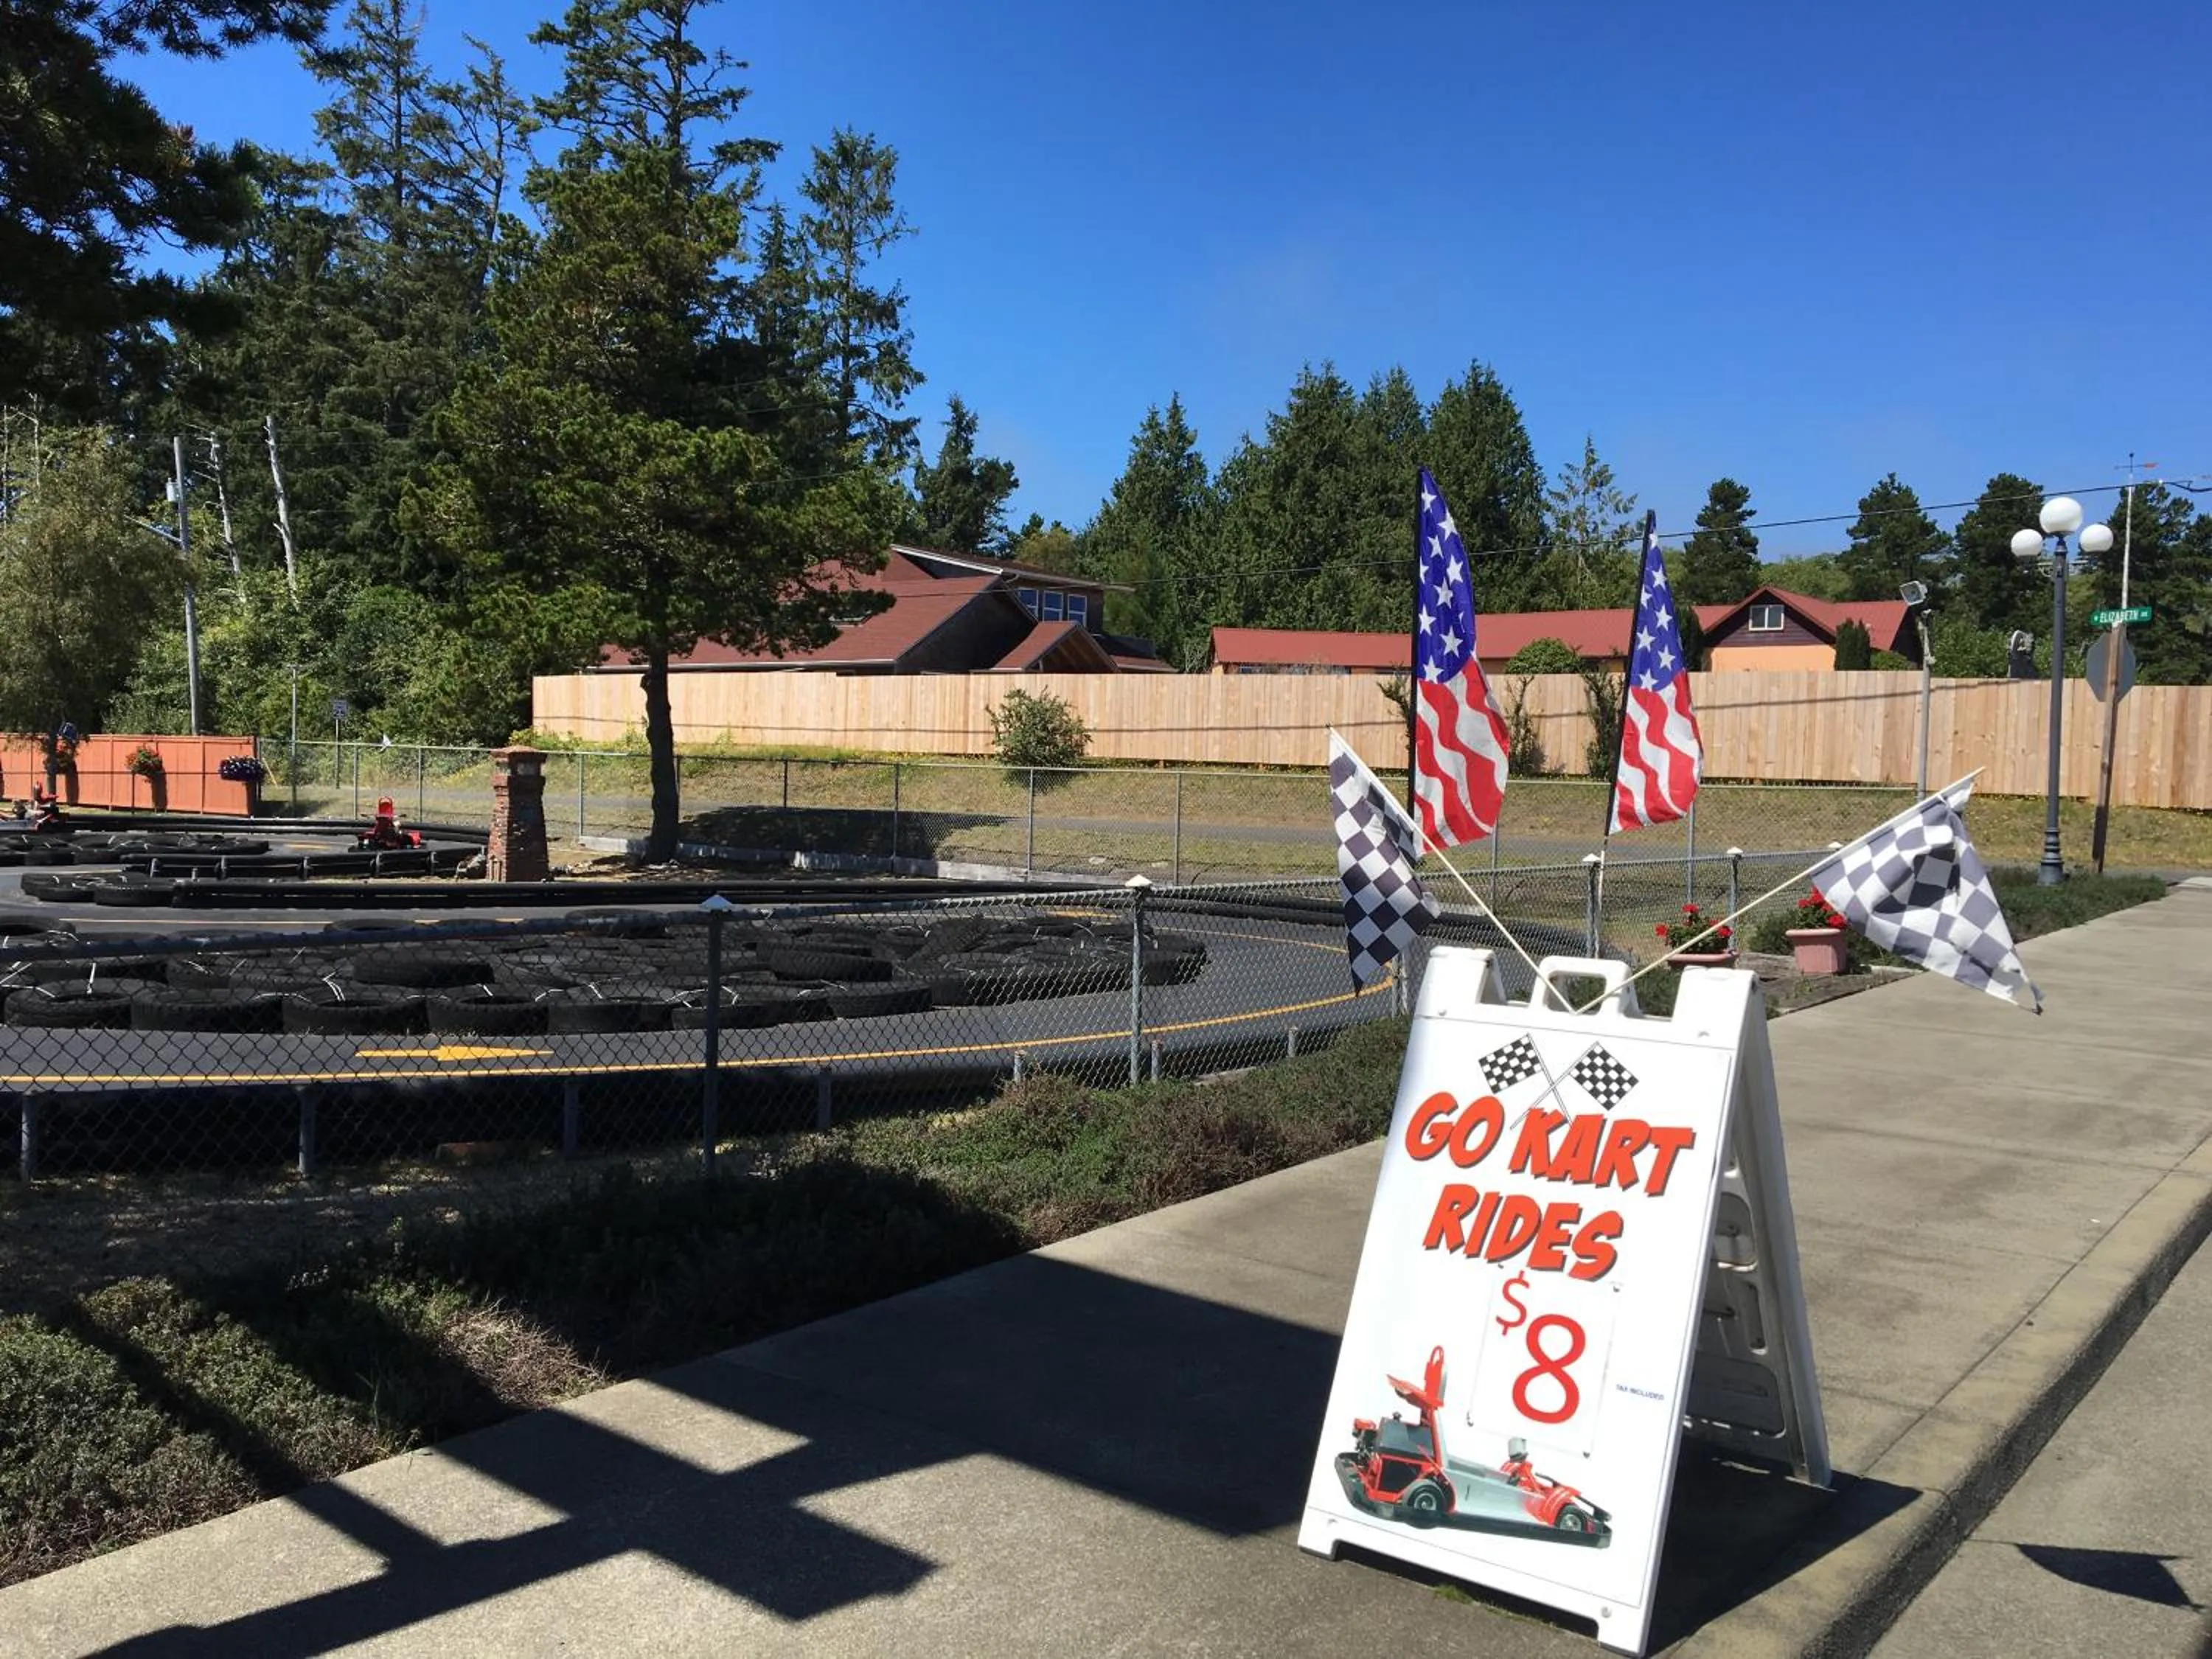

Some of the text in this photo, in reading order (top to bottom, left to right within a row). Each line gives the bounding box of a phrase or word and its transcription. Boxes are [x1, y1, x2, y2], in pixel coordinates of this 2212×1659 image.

[1405, 1092, 1696, 1197] GO KART
[1422, 1183, 1624, 1281] RIDES
